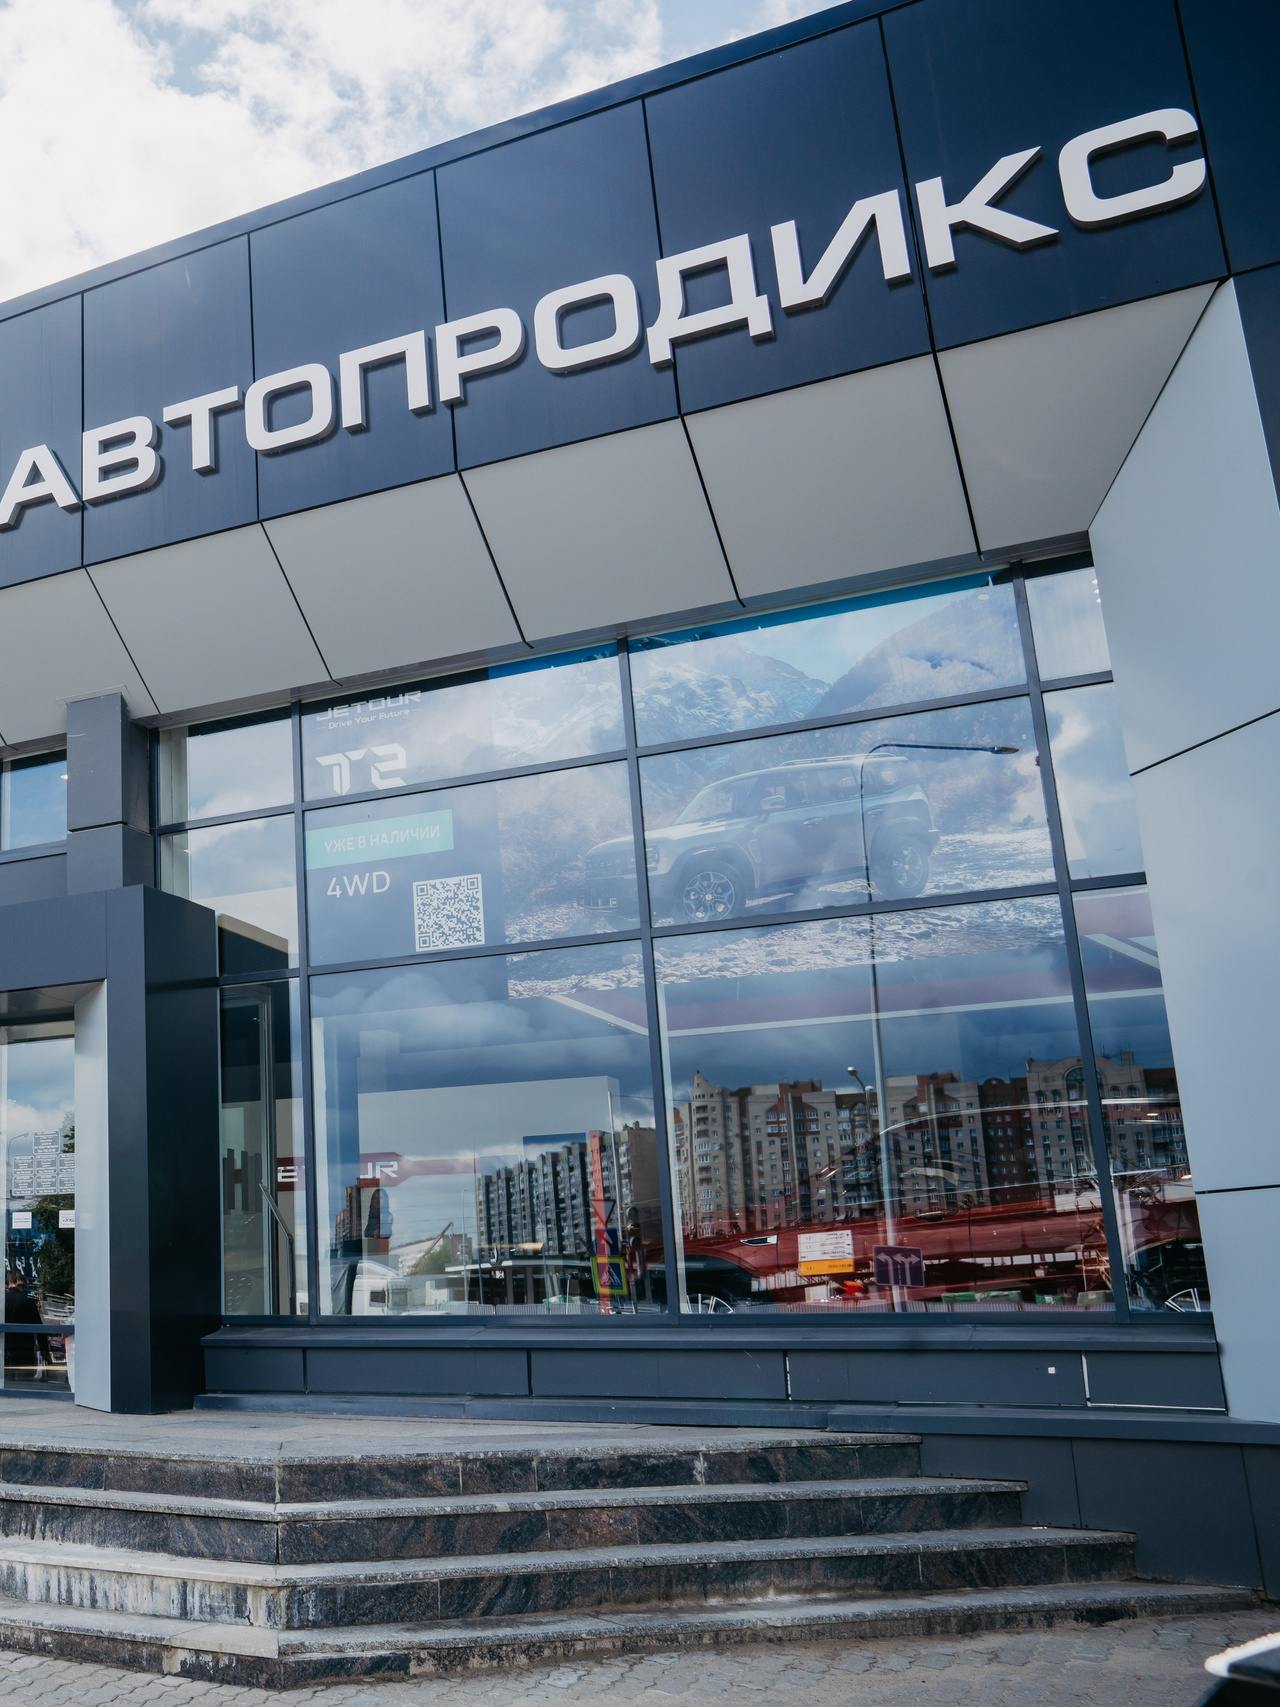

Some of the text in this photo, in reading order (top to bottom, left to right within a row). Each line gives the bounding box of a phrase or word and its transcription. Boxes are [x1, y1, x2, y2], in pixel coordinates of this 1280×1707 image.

[316, 691, 422, 721] JETOUR
[328, 708, 410, 729] Drive Your Future
[315, 743, 407, 796] T2
[324, 824, 440, 853] УЖЕ В НАЛИЧИИ
[327, 871, 391, 899] 4WD
